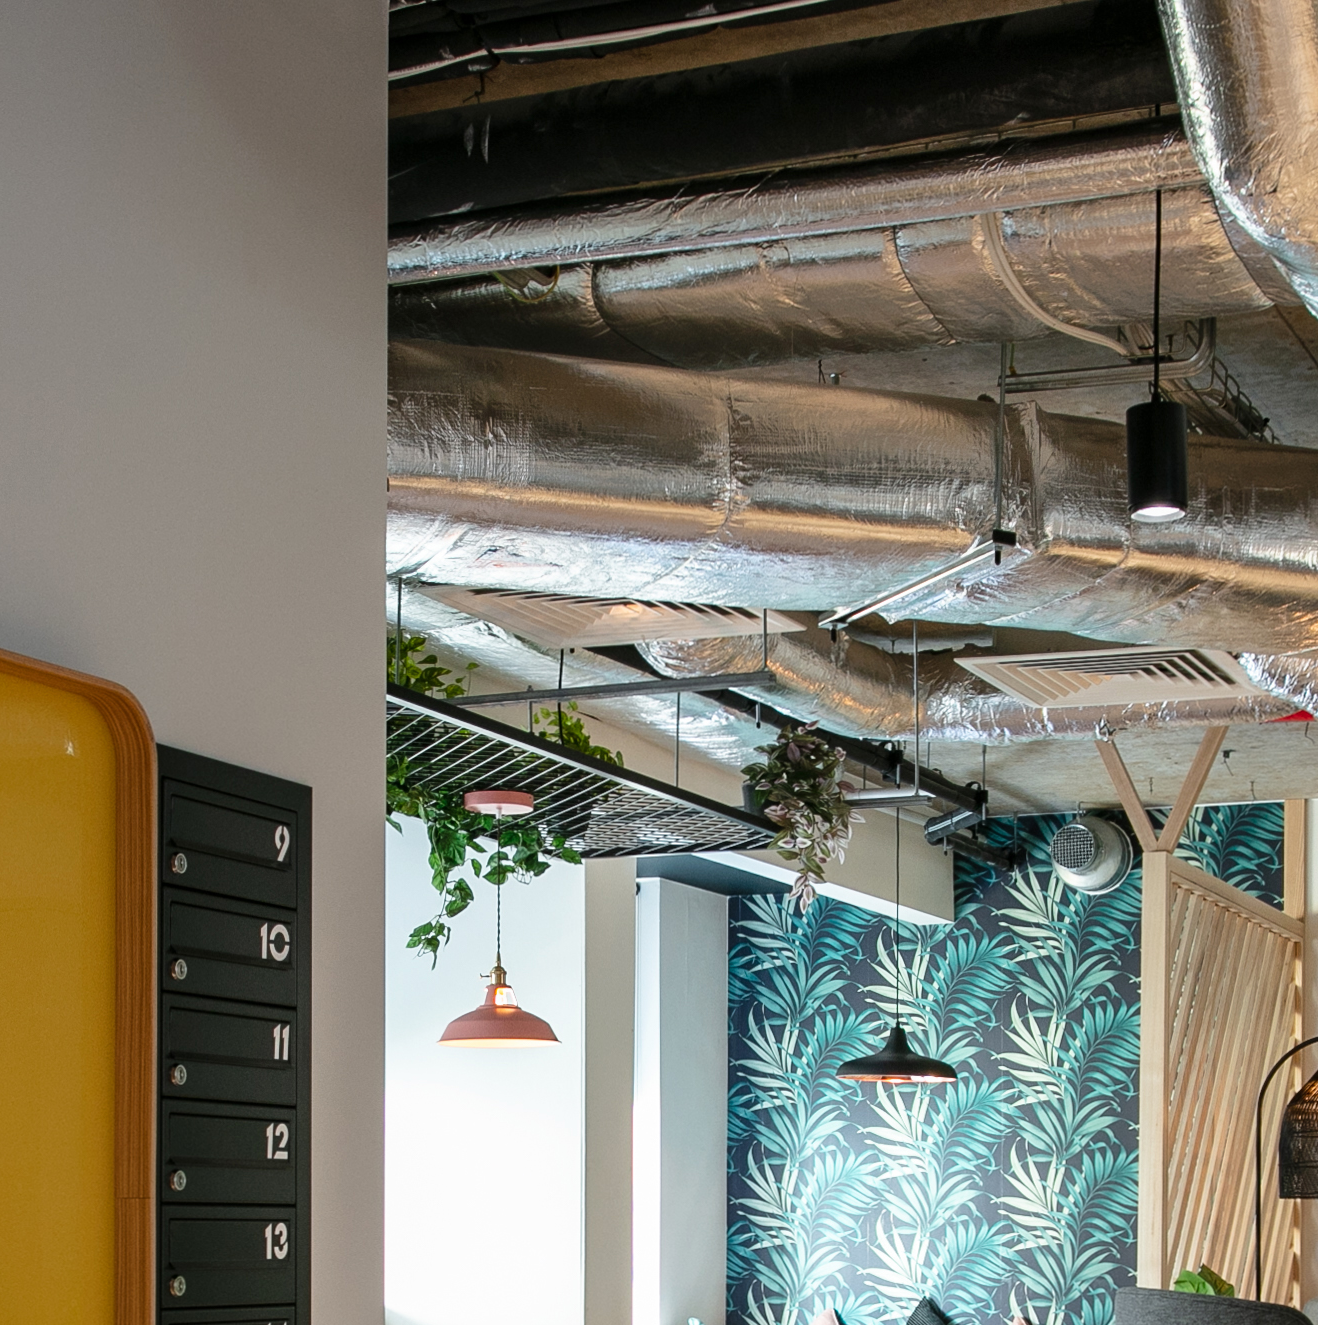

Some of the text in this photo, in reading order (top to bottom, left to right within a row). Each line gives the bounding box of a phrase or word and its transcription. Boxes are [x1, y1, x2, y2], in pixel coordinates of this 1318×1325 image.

[273, 825, 291, 863] 9
[260, 922, 291, 962] 10
[272, 1023, 290, 1061] 11
[265, 1122, 290, 1160] 12
[264, 1222, 289, 1260] 13
